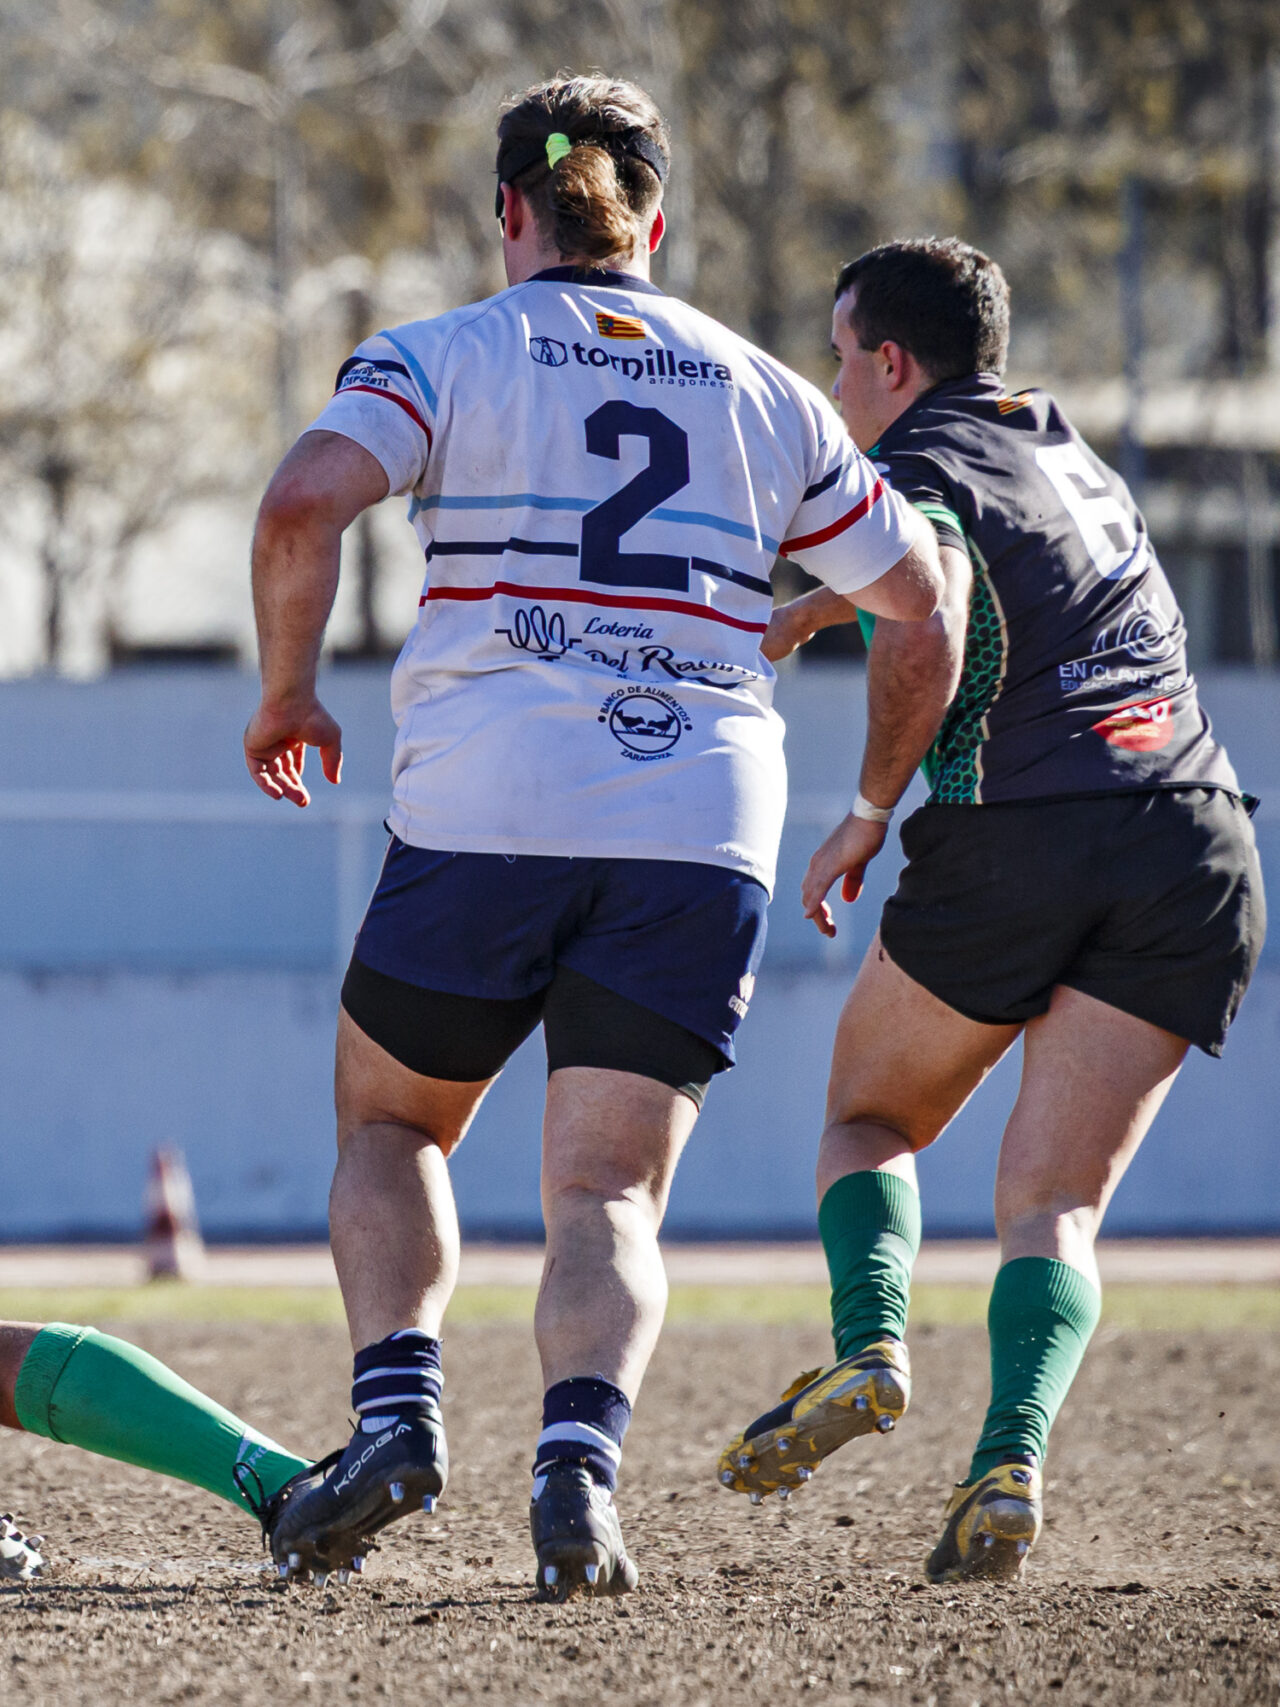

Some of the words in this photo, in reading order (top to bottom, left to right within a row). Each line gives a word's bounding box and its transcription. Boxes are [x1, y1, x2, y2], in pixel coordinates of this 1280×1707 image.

[572, 341, 733, 382] tornillera
[579, 400, 691, 593] 2
[1035, 442, 1153, 580] 6
[1059, 662, 1087, 679] EN
[600, 688, 625, 715] BANCO
[627, 685, 642, 694] DE
[643, 686, 691, 723] ALIMENTOS
[333, 1422, 413, 1496] KOOGA
